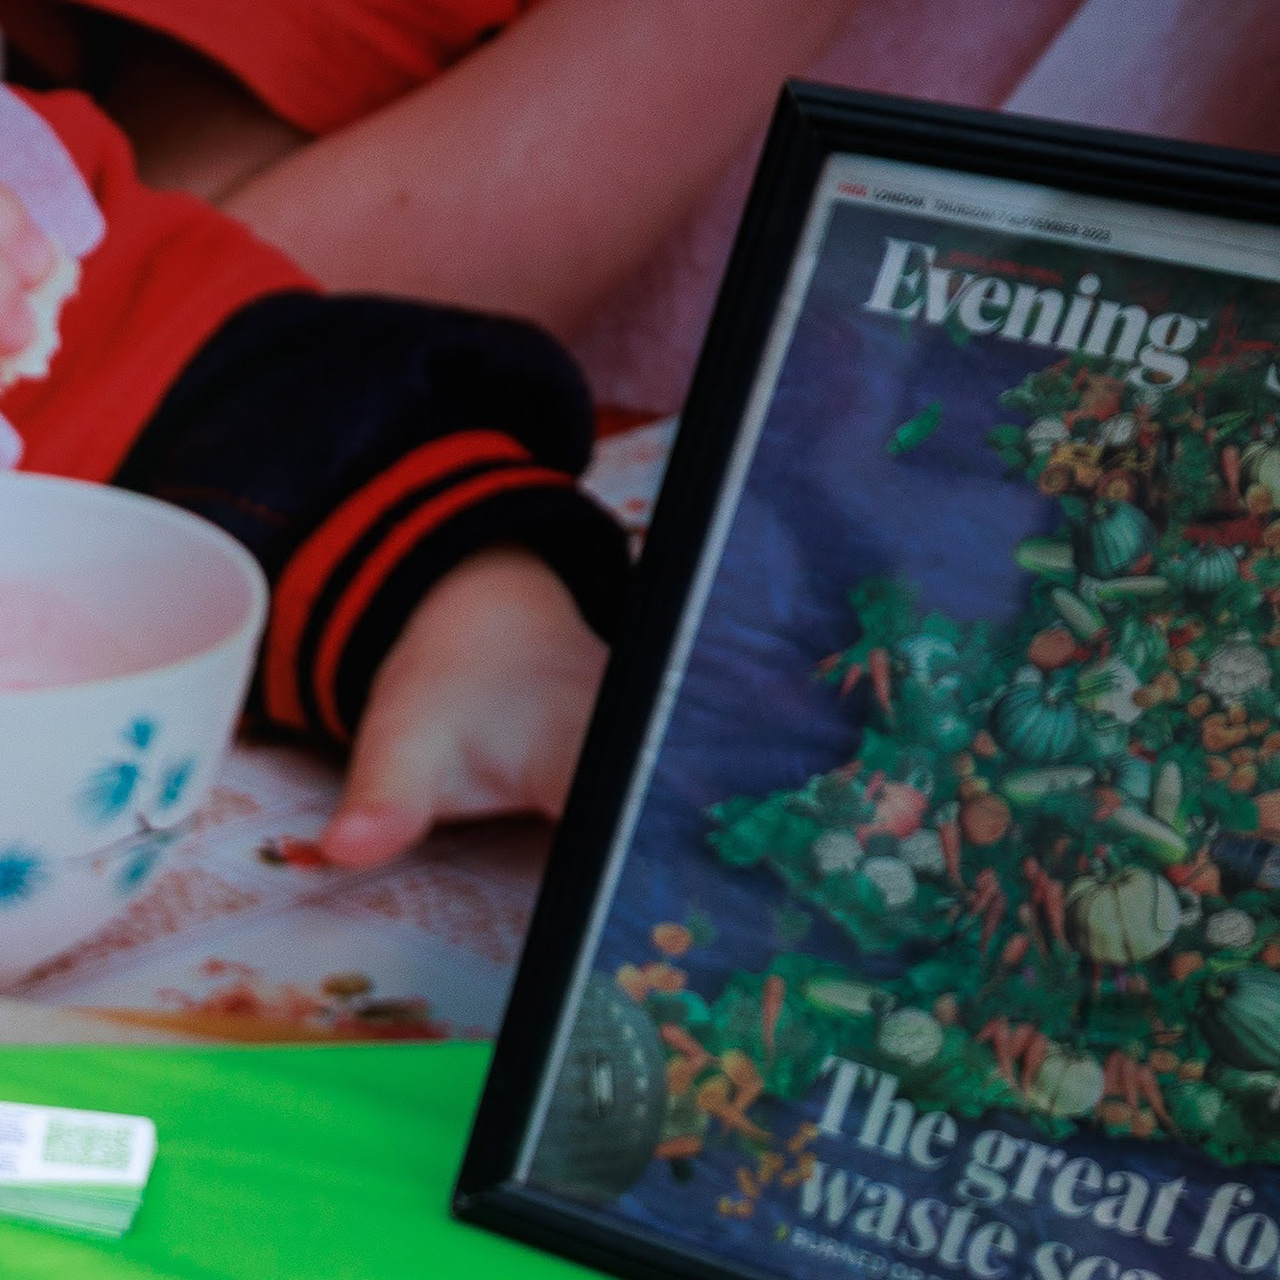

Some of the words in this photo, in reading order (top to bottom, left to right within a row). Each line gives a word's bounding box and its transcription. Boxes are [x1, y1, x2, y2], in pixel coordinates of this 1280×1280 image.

[865, 235, 1210, 391] Evening
[800, 1158, 1018, 1280] waste
[817, 1054, 958, 1171] The
[955, 1126, 1190, 1247] great
[1188, 1181, 1280, 1275] fo
